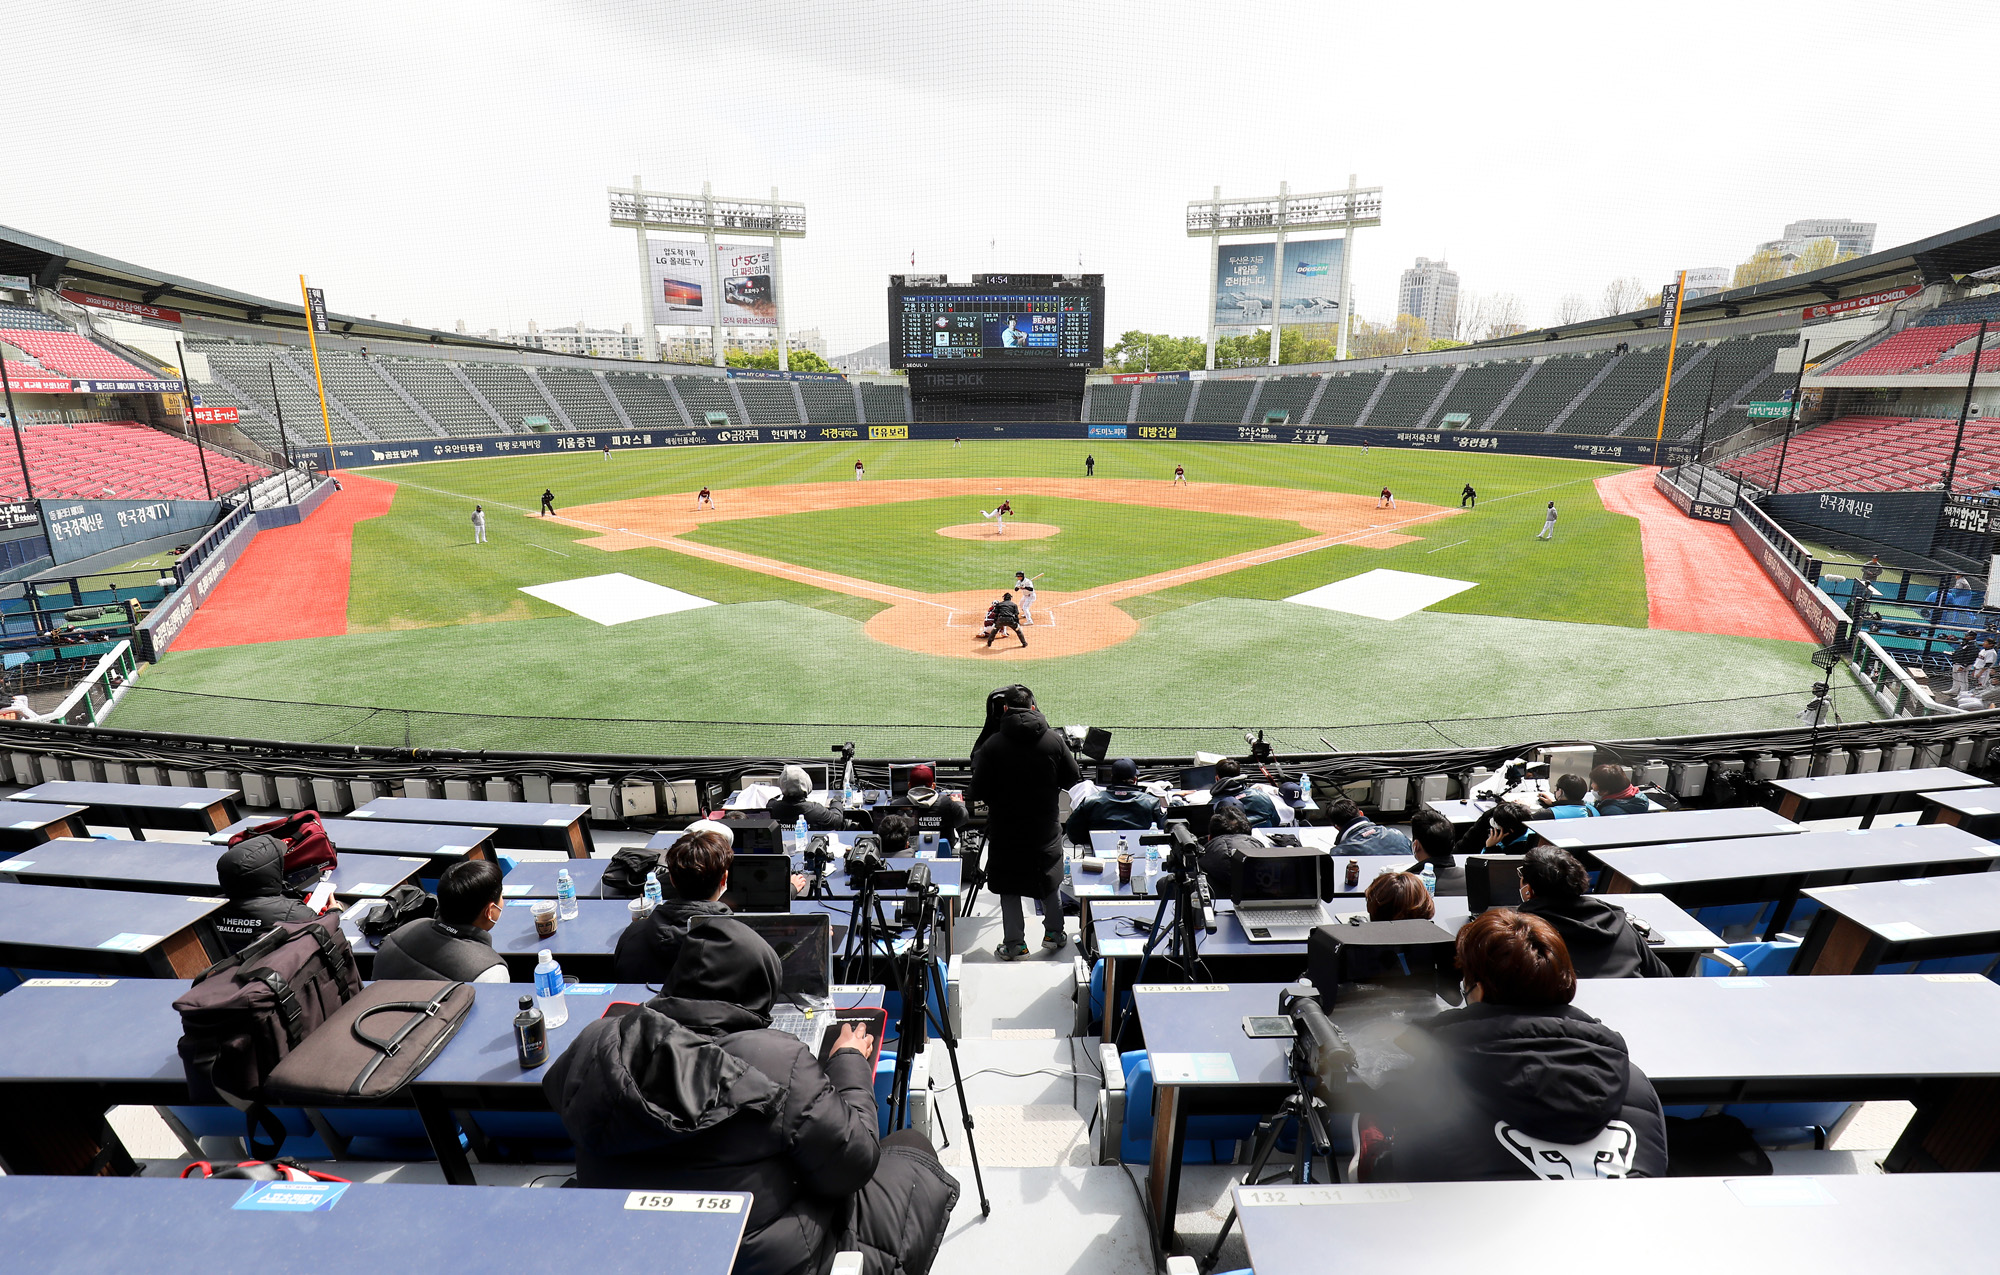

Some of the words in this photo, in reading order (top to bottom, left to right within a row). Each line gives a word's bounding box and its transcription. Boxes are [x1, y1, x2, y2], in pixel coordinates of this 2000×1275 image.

[664, 248, 684, 257] 압도적
[656, 257, 668, 265] LG
[670, 257, 692, 266] 올레드
[1228, 256, 1250, 265] 두산은
[1250, 256, 1264, 264] 지금
[740, 264, 770, 276] 짜릿하게
[1233, 265, 1258, 276] 내일을
[1296, 265, 1328, 273] DOOSAN
[986, 276, 1008, 284] 14:54
[1225, 276, 1266, 287] 준비합니다
[86, 296, 101, 304] 2020
[115, 302, 160, 317] 산삼엑스포
[924, 374, 954, 386] TIRE
[957, 374, 984, 386] PICK
[137, 382, 180, 391] 한국경제신문
[214, 409, 237, 421] 돈가스
[731, 430, 759, 441] 금강주택
[771, 429, 807, 440] 현대해상
[820, 428, 858, 439] 서경대학교
[880, 428, 906, 438] 유보라
[1095, 427, 1127, 436] 도미노피자
[1138, 426, 1177, 438] 대방건설
[557, 436, 596, 449] 키움증권
[664, 436, 707, 445] 해링턴플레이스
[1397, 432, 1440, 443] 페퍼저축은행
[444, 443, 483, 454] 유안타증권
[495, 442, 510, 450] 대광
[512, 439, 541, 449] 로제비앙
[1590, 446, 1622, 456] 겔포스엠
[1820, 494, 1873, 518] 한국경제신문
[116, 502, 170, 528] 한국경제TV
[1695, 504, 1732, 520] 백조씽크
[1959, 508, 1989, 532] 함안군
[51, 513, 104, 540] 한국경제신문
[226, 918, 262, 927] HEROES
[236, 926, 253, 934] CLUB
[1251, 1192, 1288, 1203] 132
[1364, 1188, 1400, 1200] 130
[638, 1196, 674, 1207] 159
[696, 1198, 732, 1209] 158
